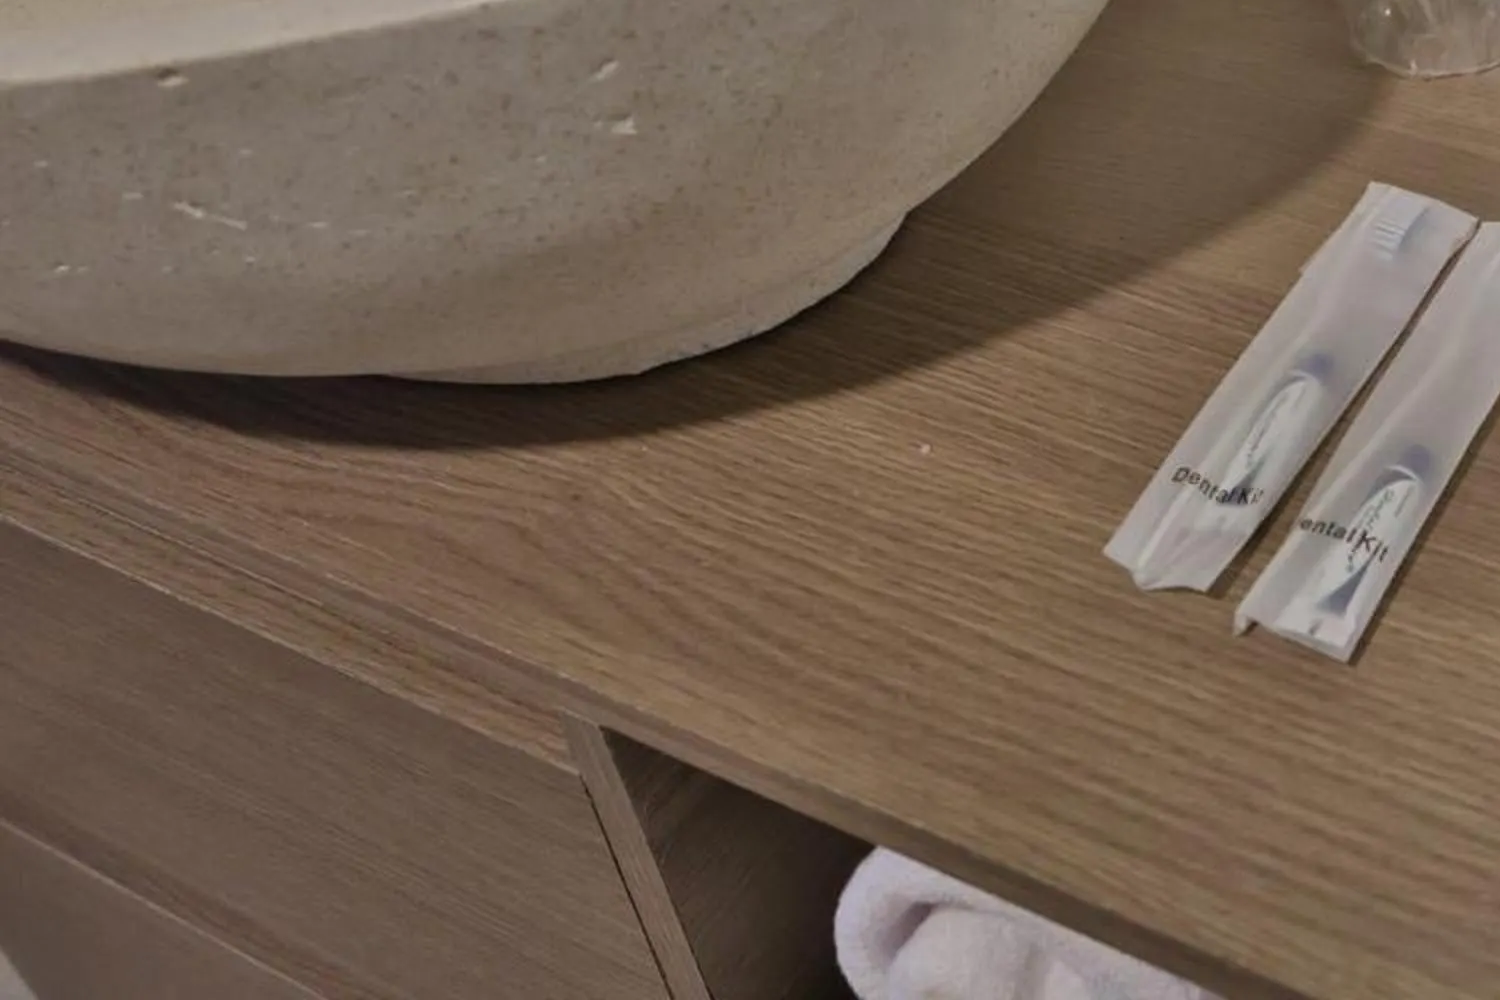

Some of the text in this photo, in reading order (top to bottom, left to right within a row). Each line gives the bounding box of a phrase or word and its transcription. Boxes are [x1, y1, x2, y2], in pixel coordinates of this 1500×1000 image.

[1171, 466, 1237, 503] Dental
[1300, 519, 1389, 562] ental Kit
